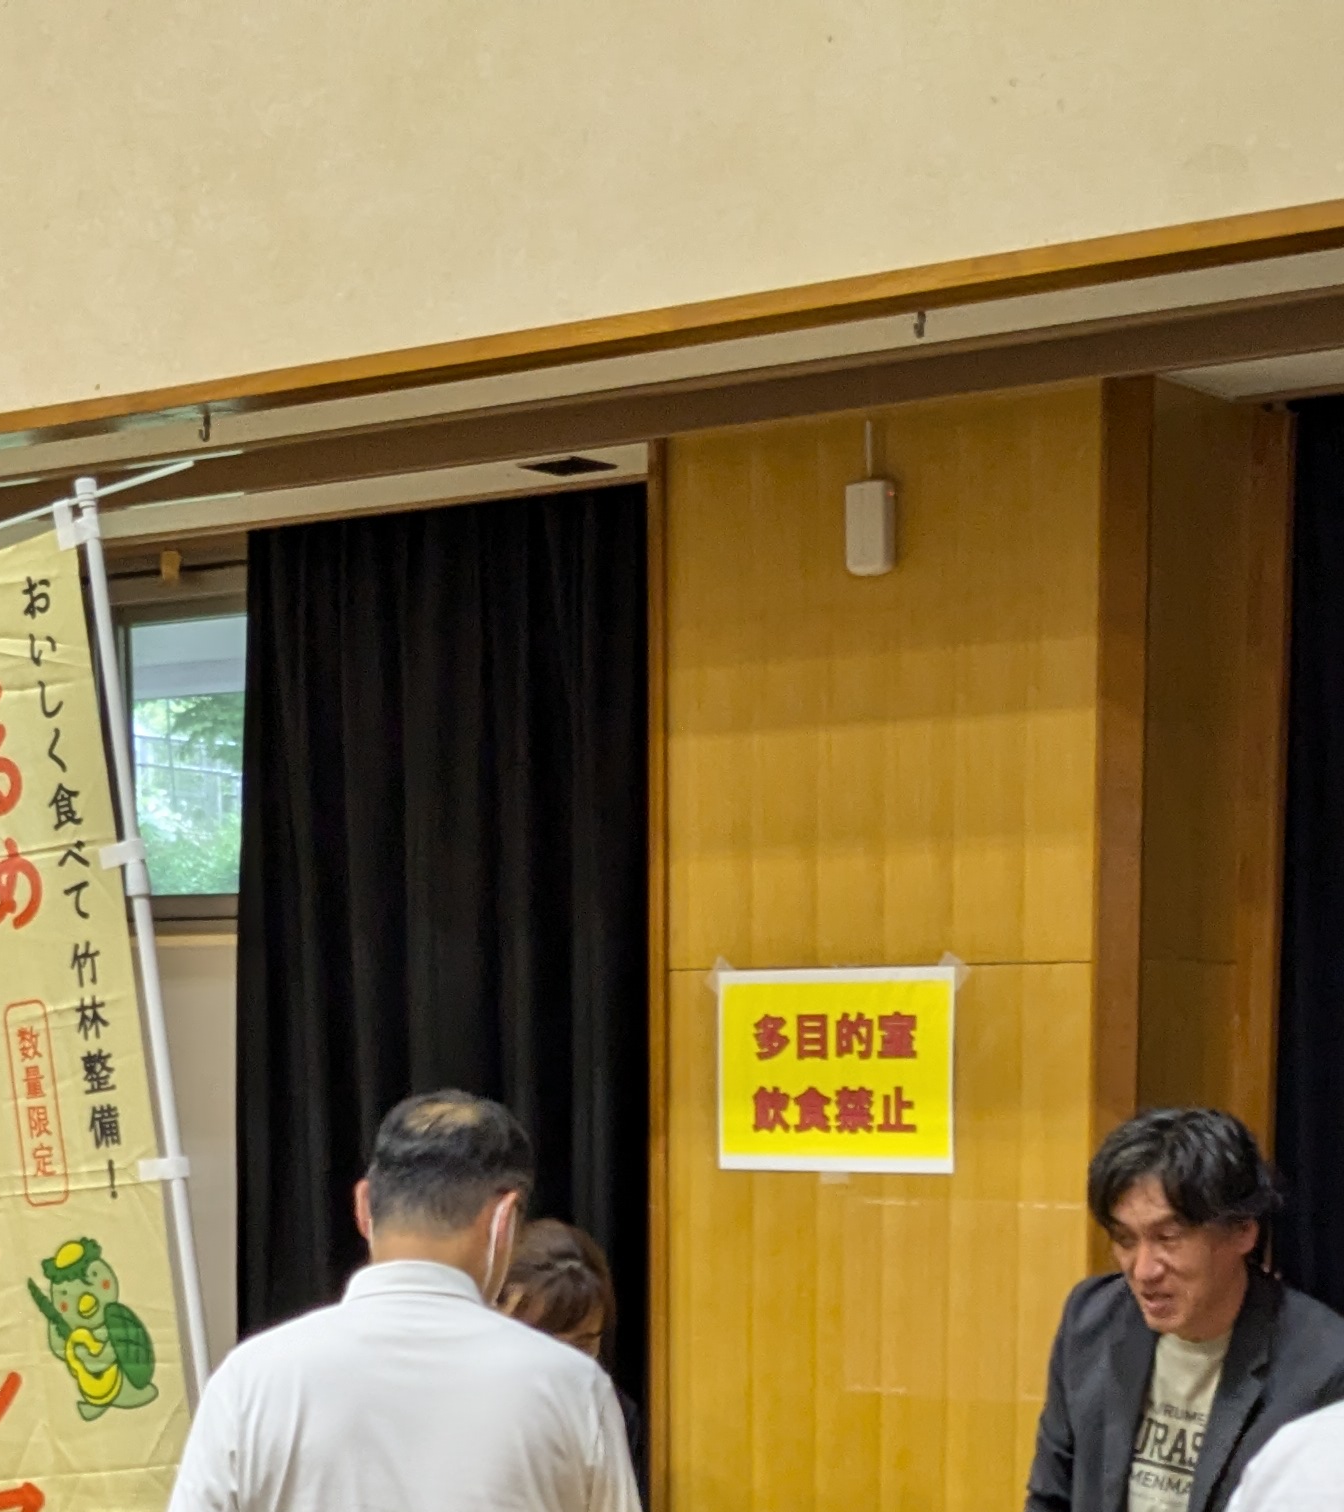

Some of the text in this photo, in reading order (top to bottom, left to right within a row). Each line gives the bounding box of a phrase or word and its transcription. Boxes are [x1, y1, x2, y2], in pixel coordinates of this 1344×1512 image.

[752, 1011, 917, 1060] 多目的室
[17, 1026, 56, 1177] 数量限定
[752, 1086, 917, 1133] 飲食禁止
